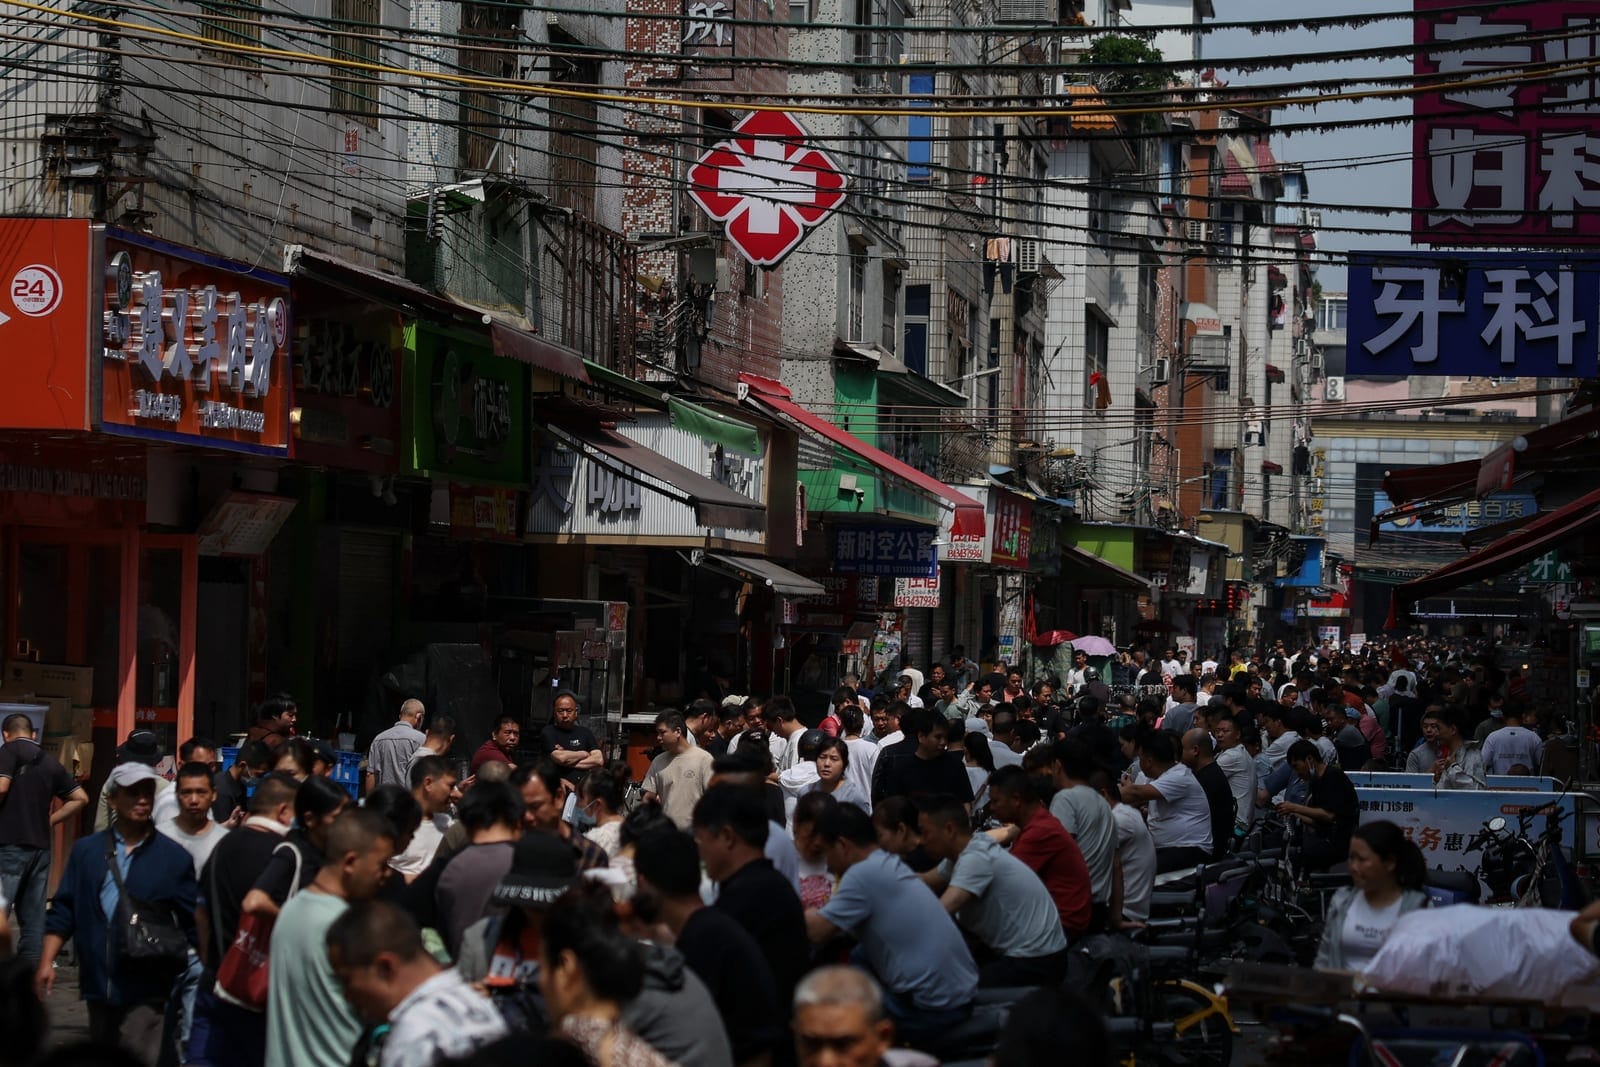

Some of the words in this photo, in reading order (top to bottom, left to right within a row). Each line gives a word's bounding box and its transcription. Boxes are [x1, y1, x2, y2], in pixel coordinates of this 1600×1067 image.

[14, 279, 45, 297] 24
[1362, 265, 1587, 376] 牙科
[837, 530, 935, 562] 新时空公寓
